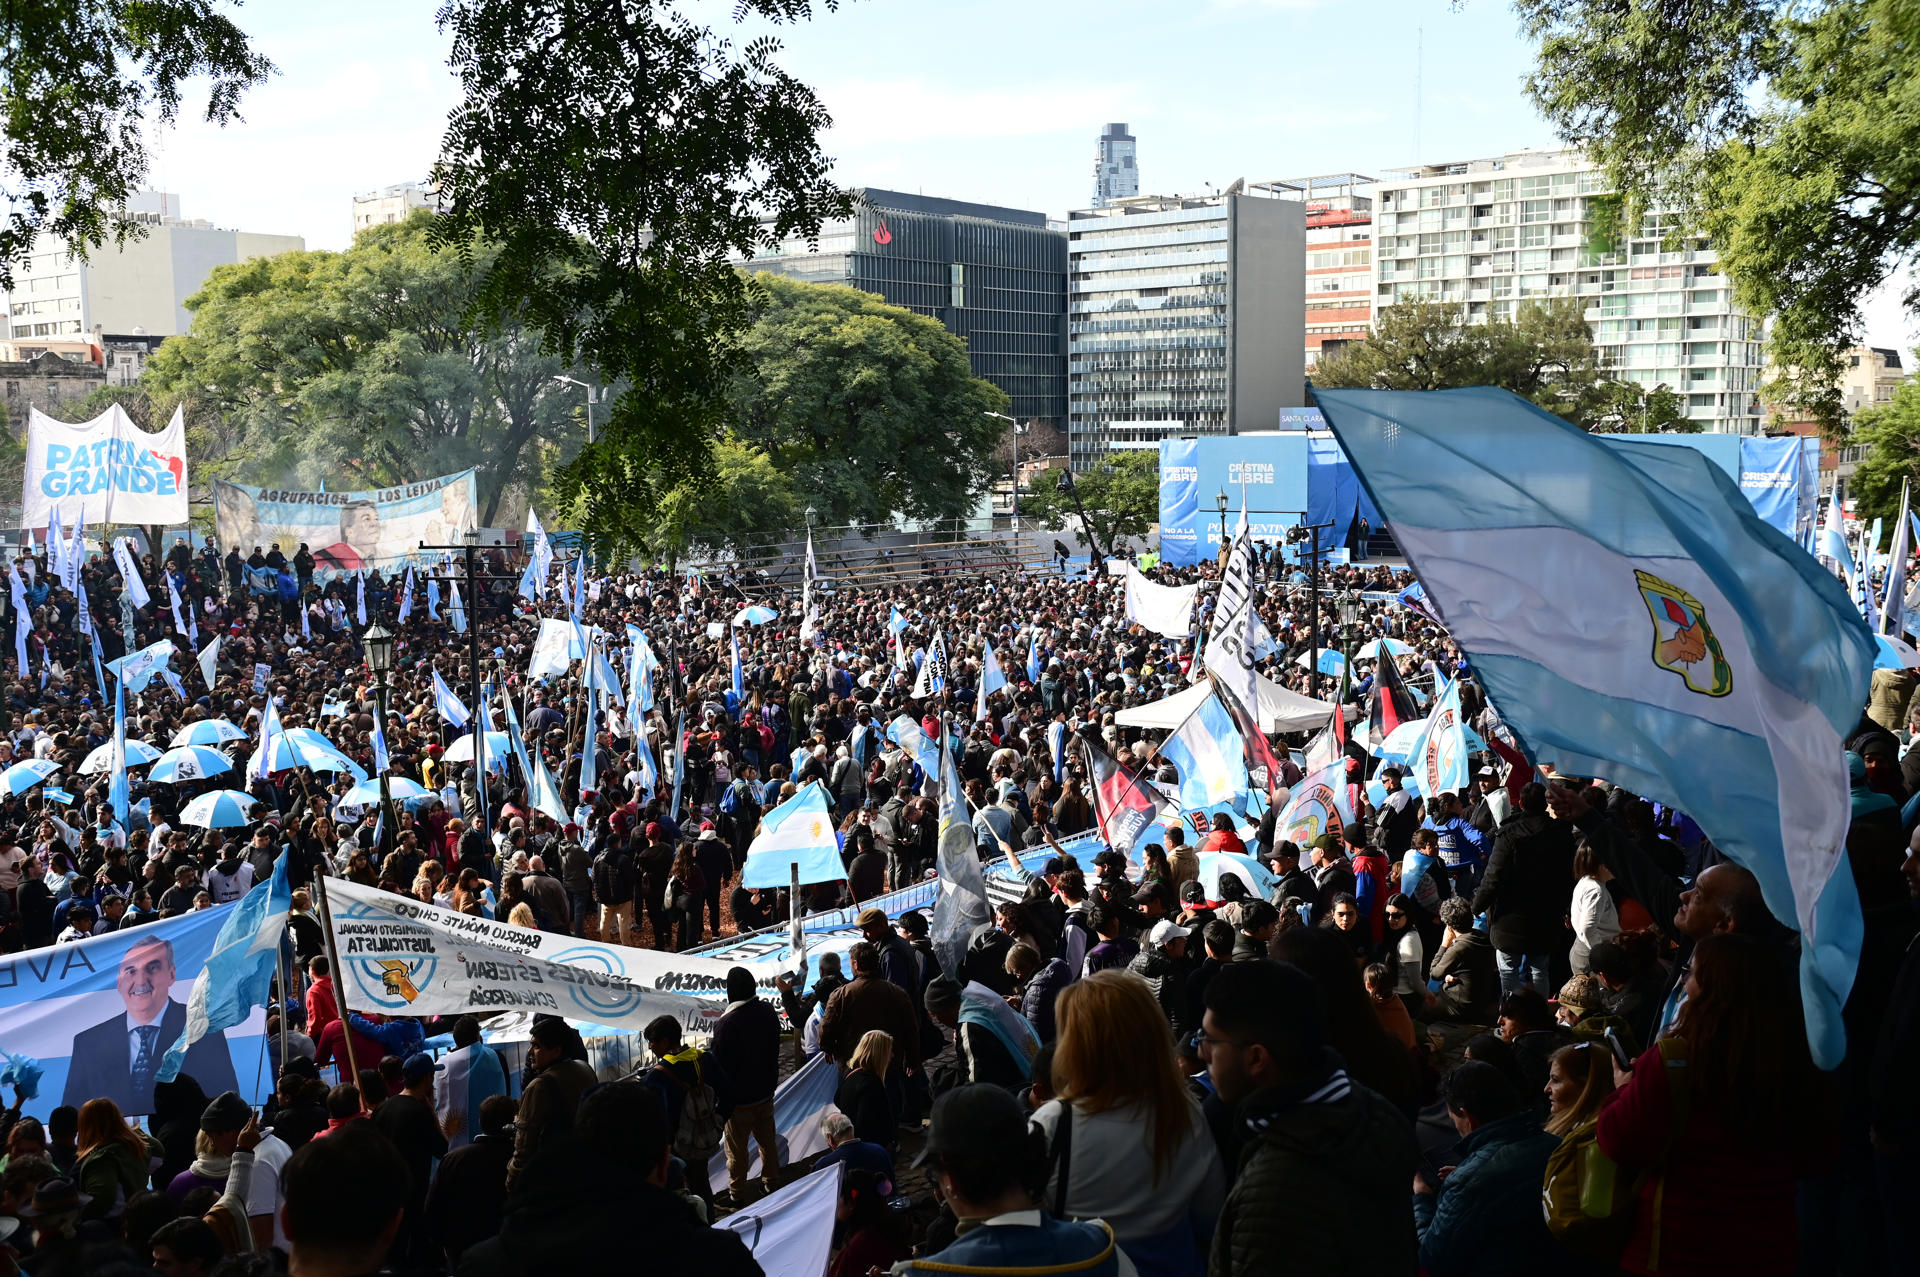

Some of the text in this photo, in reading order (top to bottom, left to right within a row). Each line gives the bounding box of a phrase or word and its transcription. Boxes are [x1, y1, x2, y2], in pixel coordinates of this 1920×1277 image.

[46, 437, 162, 471] PATRIA
[1229, 463, 1274, 473] CRSTINA
[1229, 473, 1274, 484] LIBRE
[41, 466, 176, 498] GRANDE
[257, 479, 444, 505] AGRUPACION LOS LEIVA
